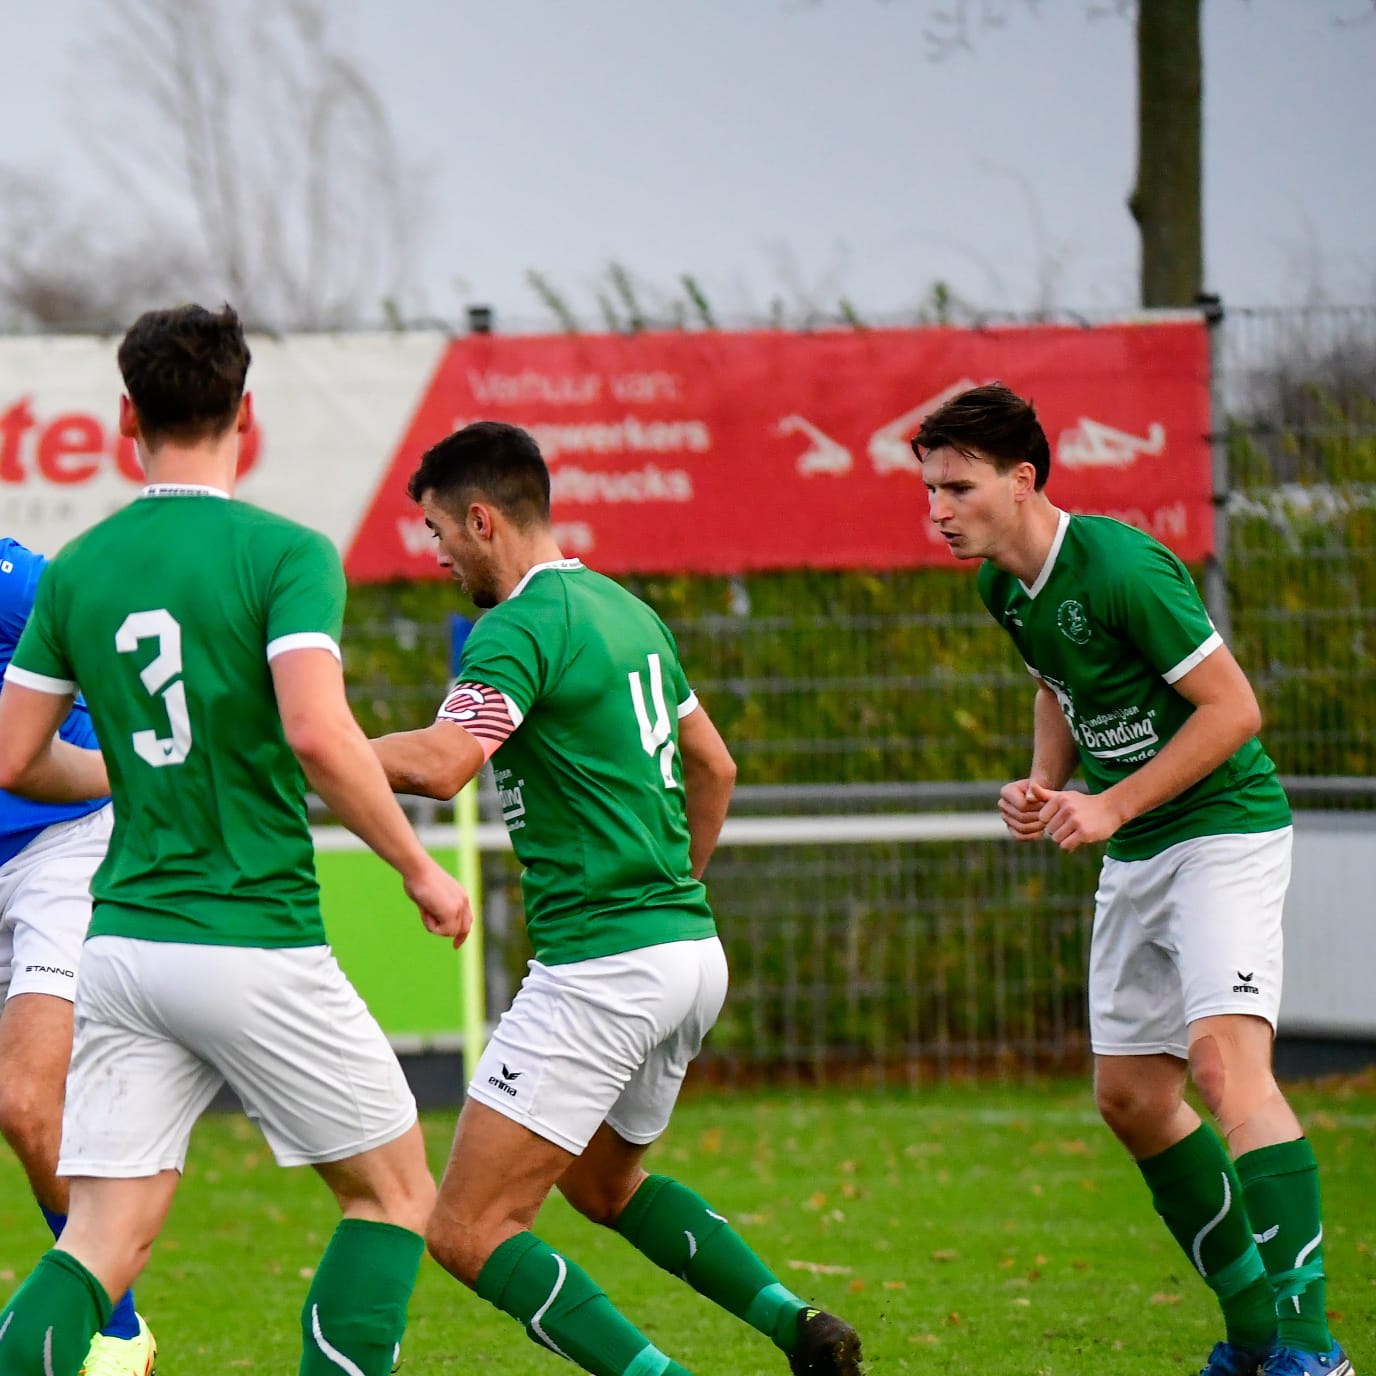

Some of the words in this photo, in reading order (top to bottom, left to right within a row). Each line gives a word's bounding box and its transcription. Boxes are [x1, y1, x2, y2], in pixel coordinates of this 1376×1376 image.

[115, 608, 192, 768] 3
[628, 653, 677, 788] 4
[25, 965, 74, 978] STANNO
[488, 1076, 518, 1097] erima
